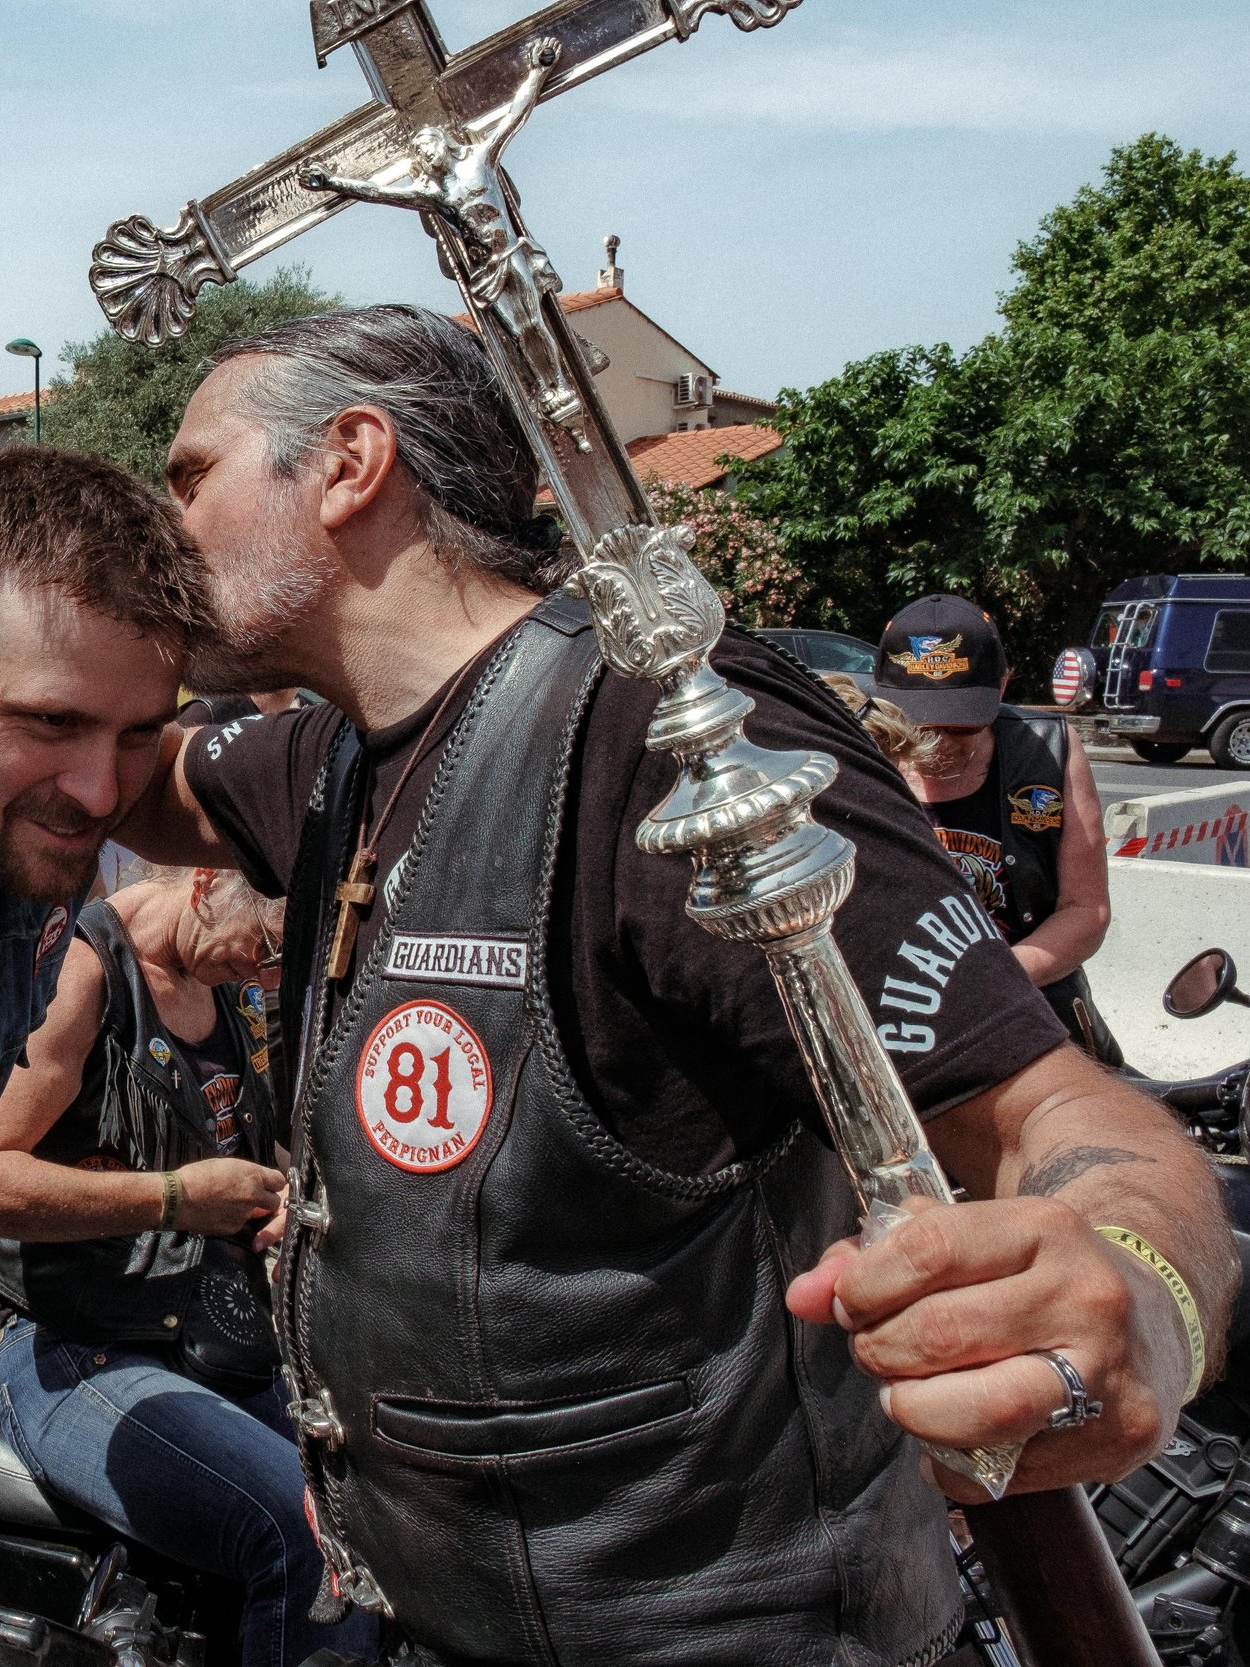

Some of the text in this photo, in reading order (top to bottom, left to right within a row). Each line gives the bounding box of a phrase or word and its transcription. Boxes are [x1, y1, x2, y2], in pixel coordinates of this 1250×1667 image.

[392, 941, 523, 978] GUARDIANS
[876, 893, 1002, 1053] GUARDI
[364, 1010, 486, 1091] SUPPORT YOUR LOCAL
[383, 1041, 455, 1130] 81
[371, 1119, 467, 1164] PERPIGNAN
